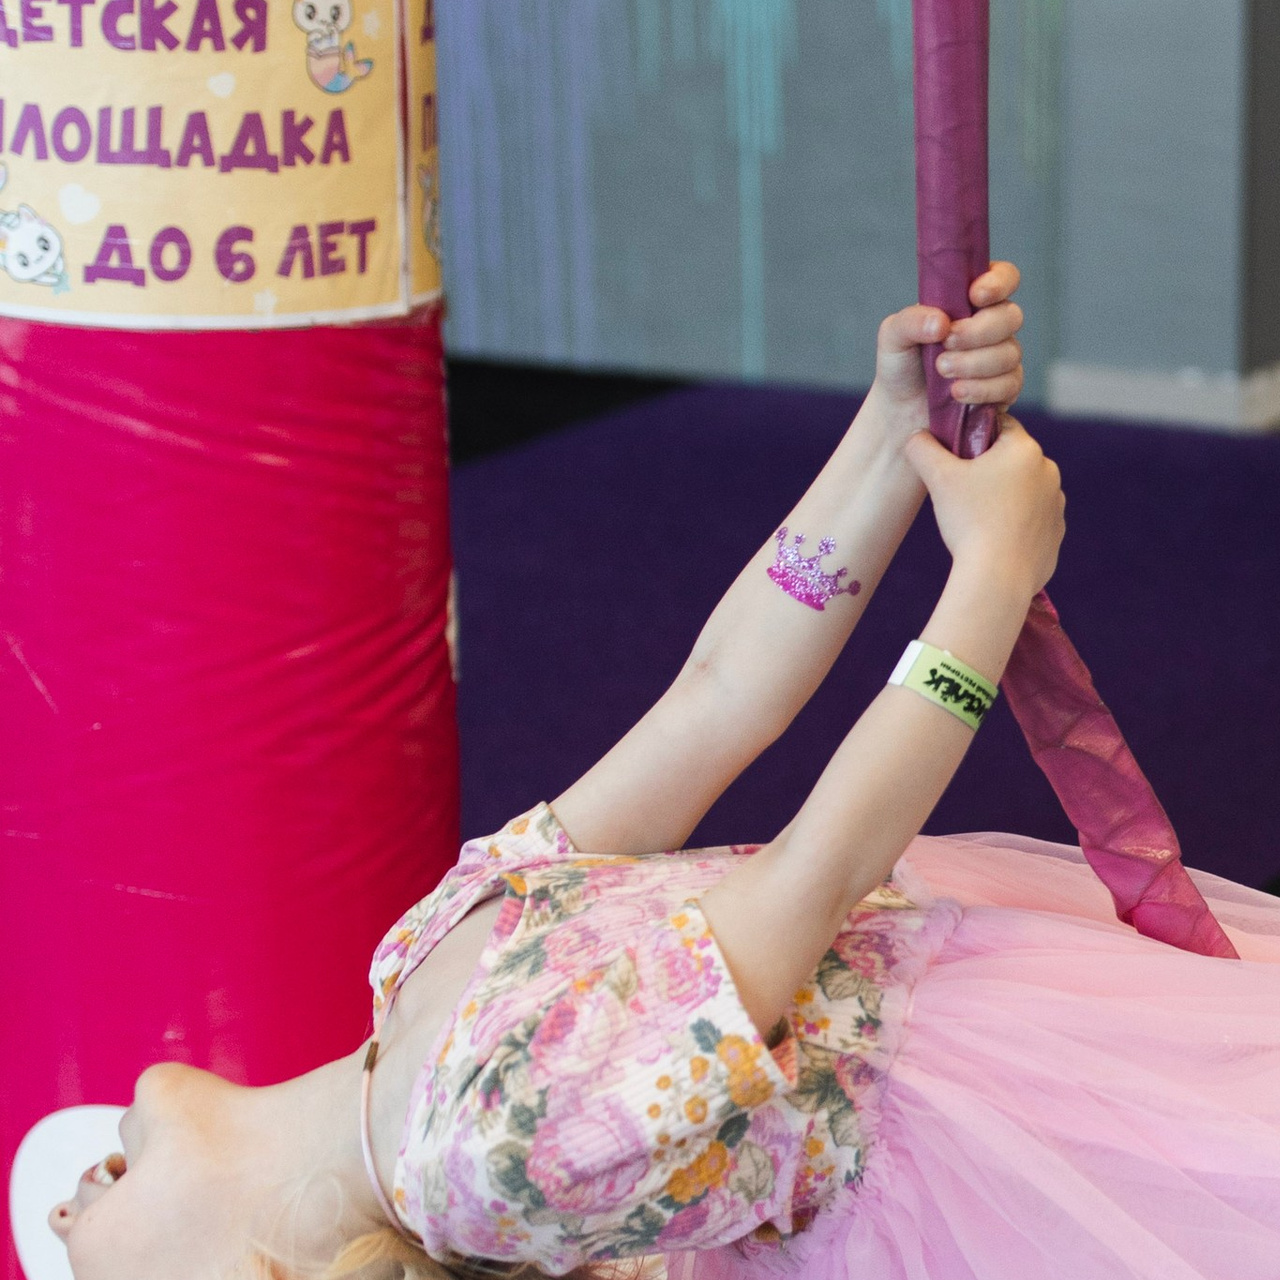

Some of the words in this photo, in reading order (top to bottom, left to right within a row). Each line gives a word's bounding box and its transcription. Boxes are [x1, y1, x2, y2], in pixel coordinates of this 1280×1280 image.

[0, 97, 351, 173] ЛОЩАДКА
[83, 224, 192, 287] ДО
[214, 225, 256, 283] 6
[277, 218, 376, 279] ЛЕТ
